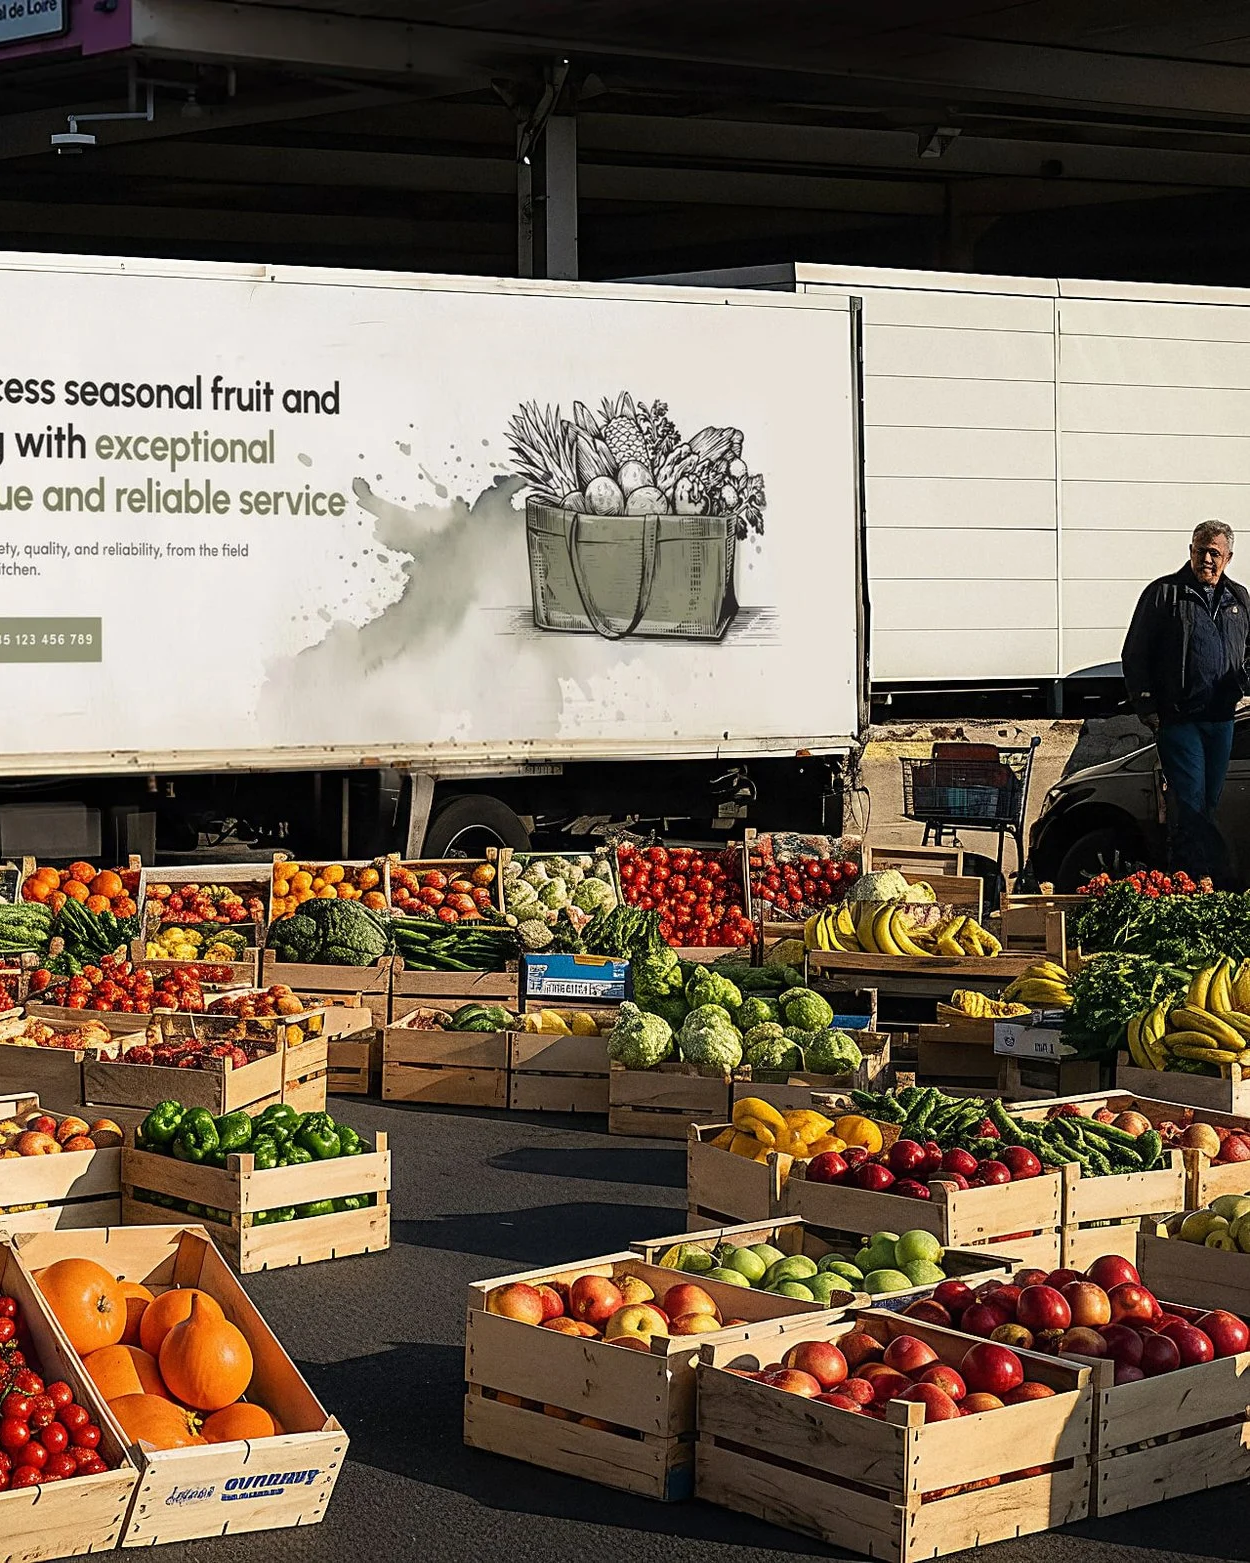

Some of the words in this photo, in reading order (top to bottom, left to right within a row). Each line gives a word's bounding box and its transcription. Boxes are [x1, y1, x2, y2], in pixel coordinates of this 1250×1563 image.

[9, 3, 25, 19] de
[27, 0, 57, 15] Loire
[64, 374, 202, 410] seasonal
[210, 375, 275, 412] fruit
[281, 381, 340, 415] and
[14, 423, 86, 459] with
[94, 429, 275, 472] exceptional
[42, 477, 105, 512] and
[115, 478, 231, 515] reliable
[239, 484, 346, 516] service
[24, 541, 71, 559] quality,
[74, 542, 99, 555] and
[102, 542, 163, 560] reliability,
[166, 542, 196, 556] from
[199, 543, 219, 557] the
[222, 543, 249, 557] field
[16, 634, 36, 645] 123
[41, 634, 65, 645] 456
[70, 634, 93, 645] 789
